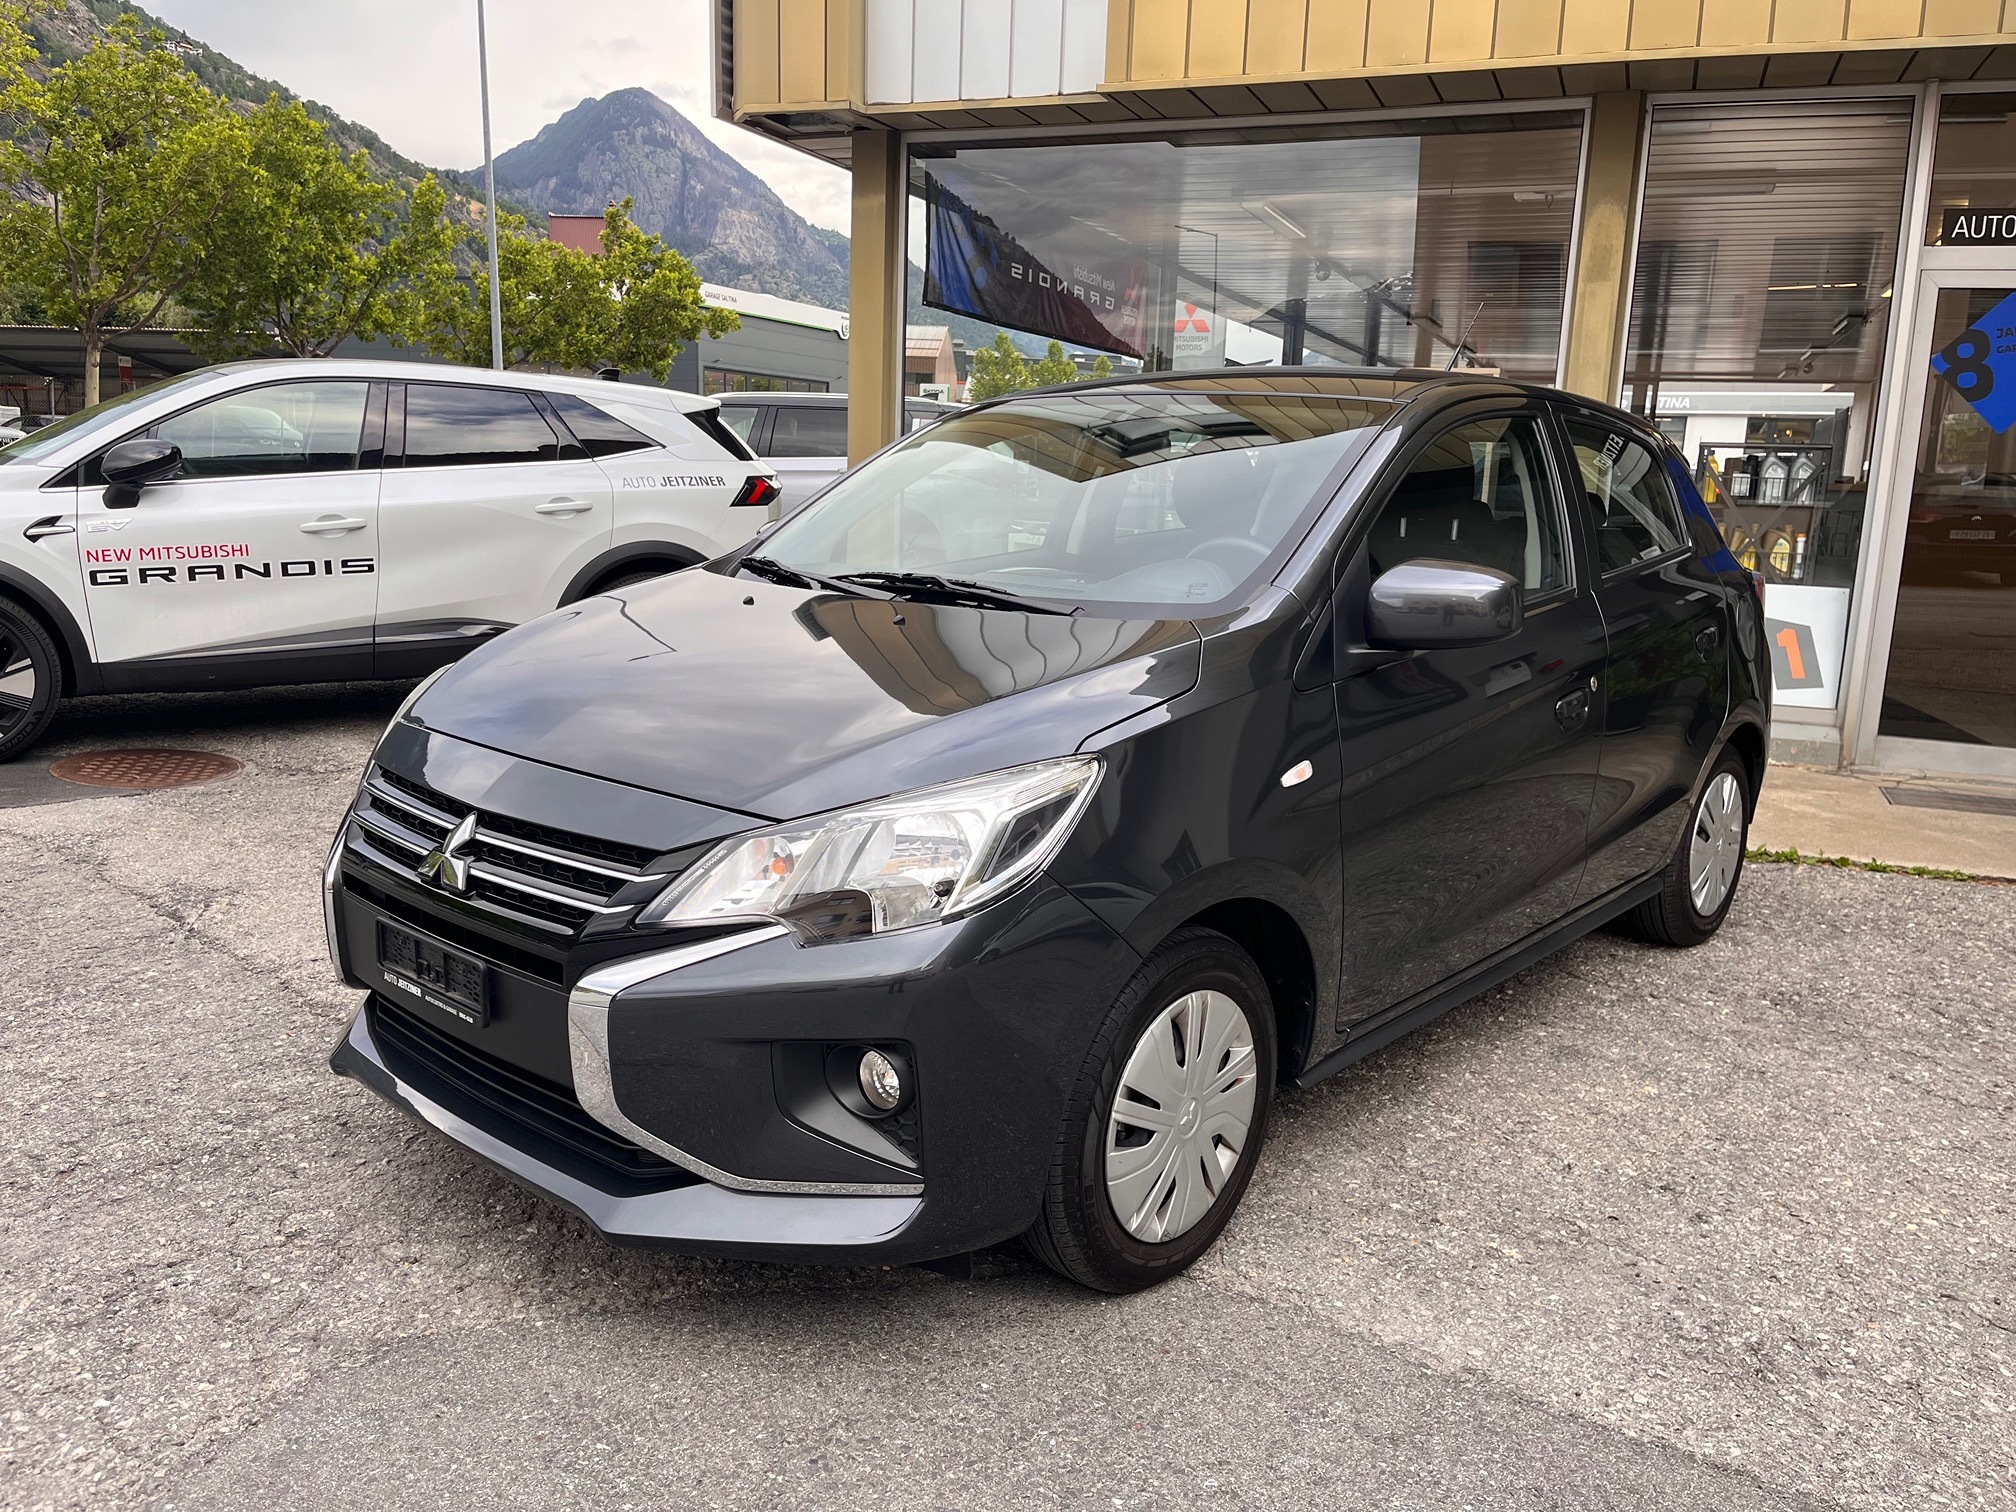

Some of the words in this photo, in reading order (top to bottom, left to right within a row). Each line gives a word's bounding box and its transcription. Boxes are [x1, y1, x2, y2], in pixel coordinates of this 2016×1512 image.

[1951, 214, 2016, 239] AUTO
[704, 291, 721, 300] GARAGE
[1175, 343, 1203, 351] MOTORS
[1941, 328, 1994, 402] 8
[622, 476, 657, 489] AUTO
[660, 475, 726, 488] JEITZINER
[86, 548, 132, 563] NEW
[139, 544, 250, 561] MITSUBISHI
[88, 557, 375, 587] GRANDIS
[1776, 627, 1806, 679] 1
[383, 971, 398, 985] AUTO
